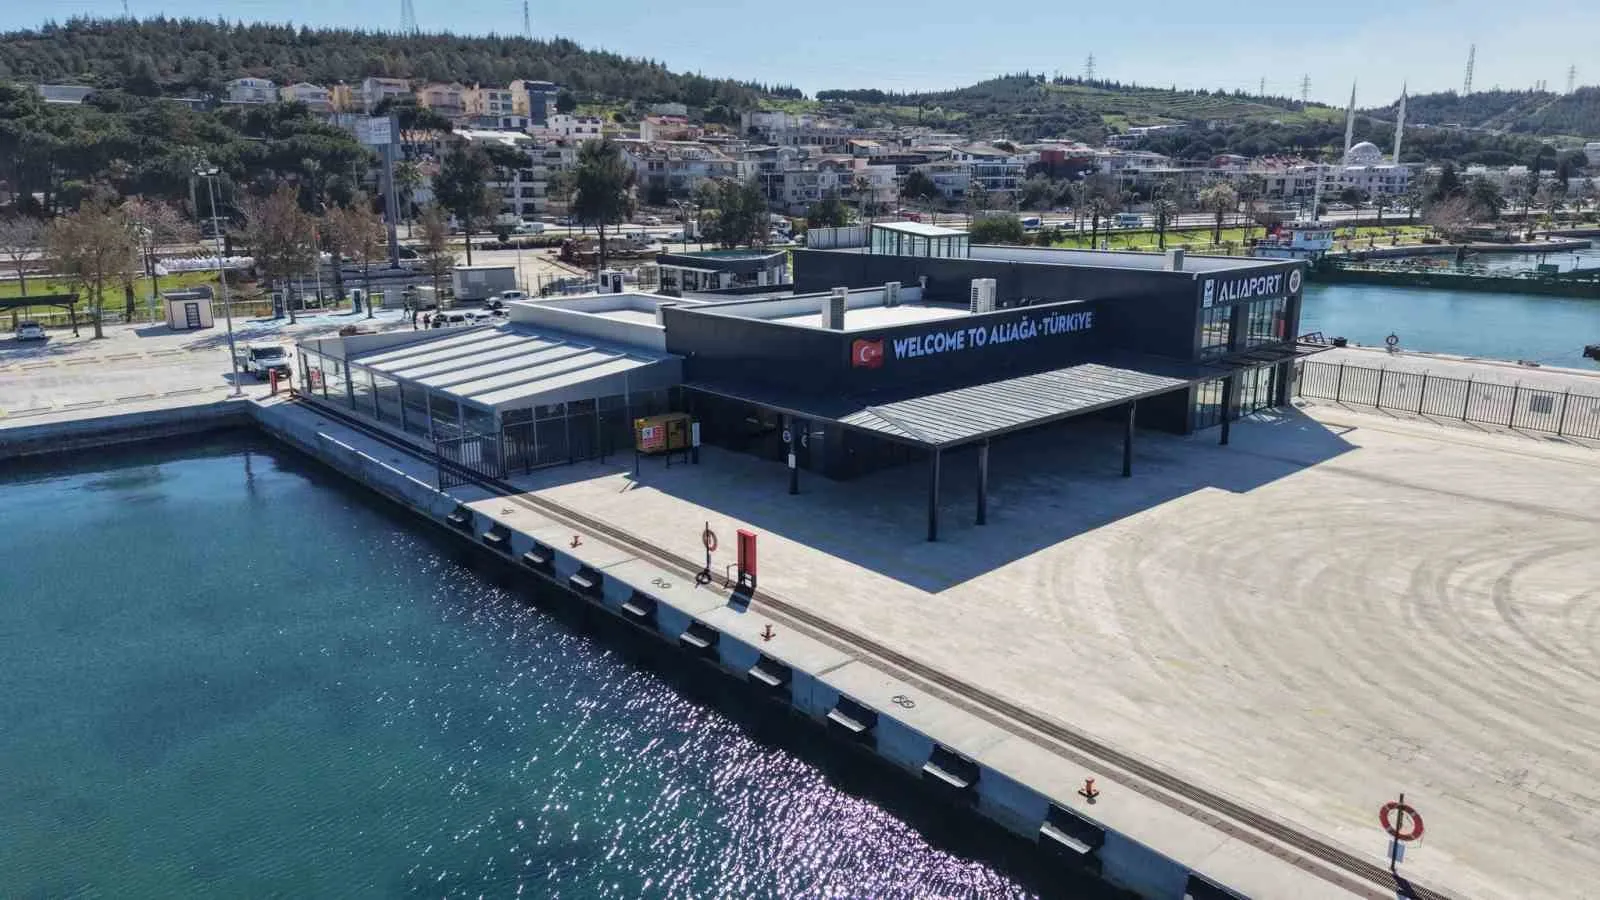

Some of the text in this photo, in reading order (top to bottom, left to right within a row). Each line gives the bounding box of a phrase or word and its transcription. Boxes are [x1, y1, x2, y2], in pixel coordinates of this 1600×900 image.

[1219, 273, 1281, 302] ALIAPORT
[893, 331, 965, 360] WELCOME
[968, 327, 986, 347] TO
